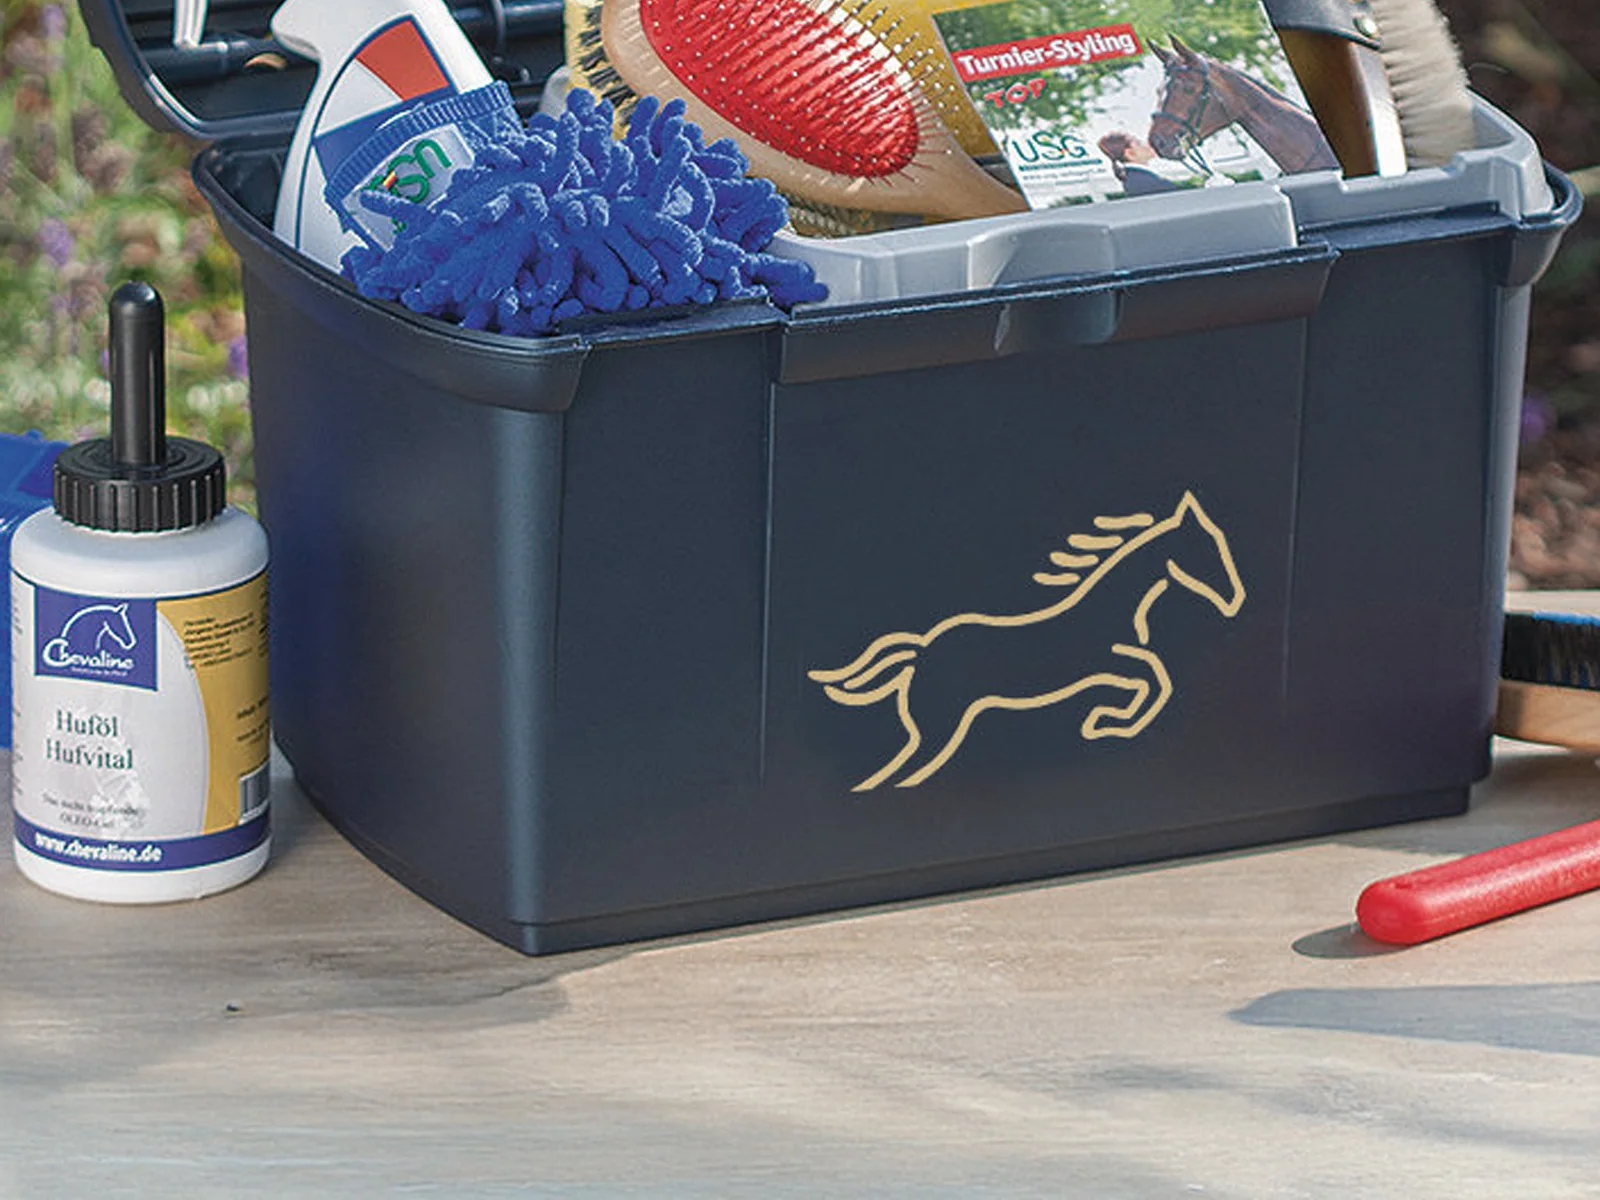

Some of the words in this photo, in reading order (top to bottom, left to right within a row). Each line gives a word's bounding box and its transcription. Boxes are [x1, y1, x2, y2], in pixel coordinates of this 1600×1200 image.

[958, 32, 1136, 76] Turnier-Styling
[983, 77, 1048, 109] TOP
[1011, 130, 1089, 164] USG
[56, 709, 119, 738] Huföl
[46, 738, 135, 771] Hufvital
[35, 831, 163, 864] www.chevaline.de
